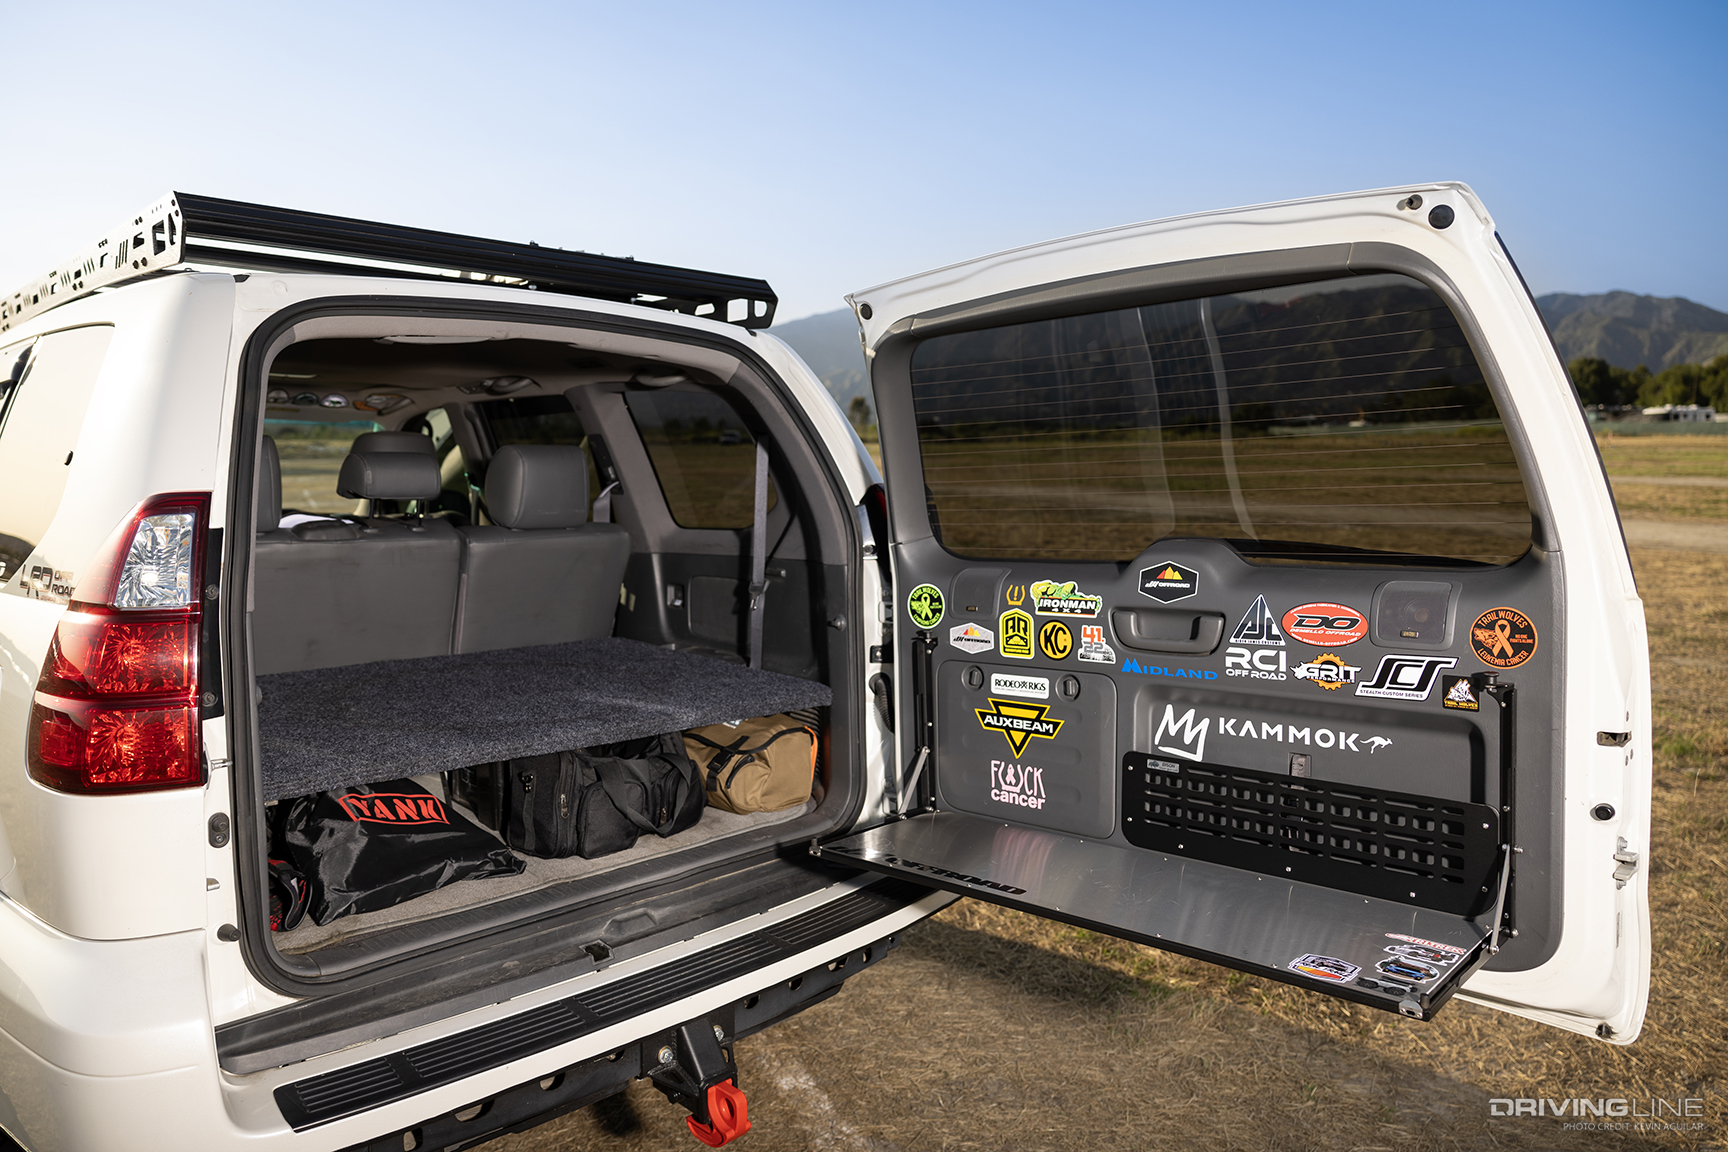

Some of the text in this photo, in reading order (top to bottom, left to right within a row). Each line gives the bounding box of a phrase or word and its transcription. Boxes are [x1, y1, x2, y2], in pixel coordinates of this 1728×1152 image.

[1039, 599, 1096, 610] IRONMAN
[1477, 610, 1528, 629] TRAIL WOLVES
[1044, 624, 1067, 656] KC
[1324, 629, 1362, 637] OFFROAD
[1226, 647, 1287, 673] RCI
[1477, 648, 1529, 666] LEUKEMIA CANCER
[1121, 657, 1218, 680] MIDLAND
[1226, 668, 1287, 681] OFF ROAD
[1306, 663, 1362, 680] GRIT
[995, 679, 1020, 689] RODEO
[1028, 681, 1046, 692] RIGS
[1306, 675, 1355, 683] PERFORMANCE
[983, 715, 1053, 734] AUXBEAM
[1218, 716, 1361, 752] KAMMOK
[990, 788, 1046, 810] cancer
[347, 798, 442, 821] YANK
